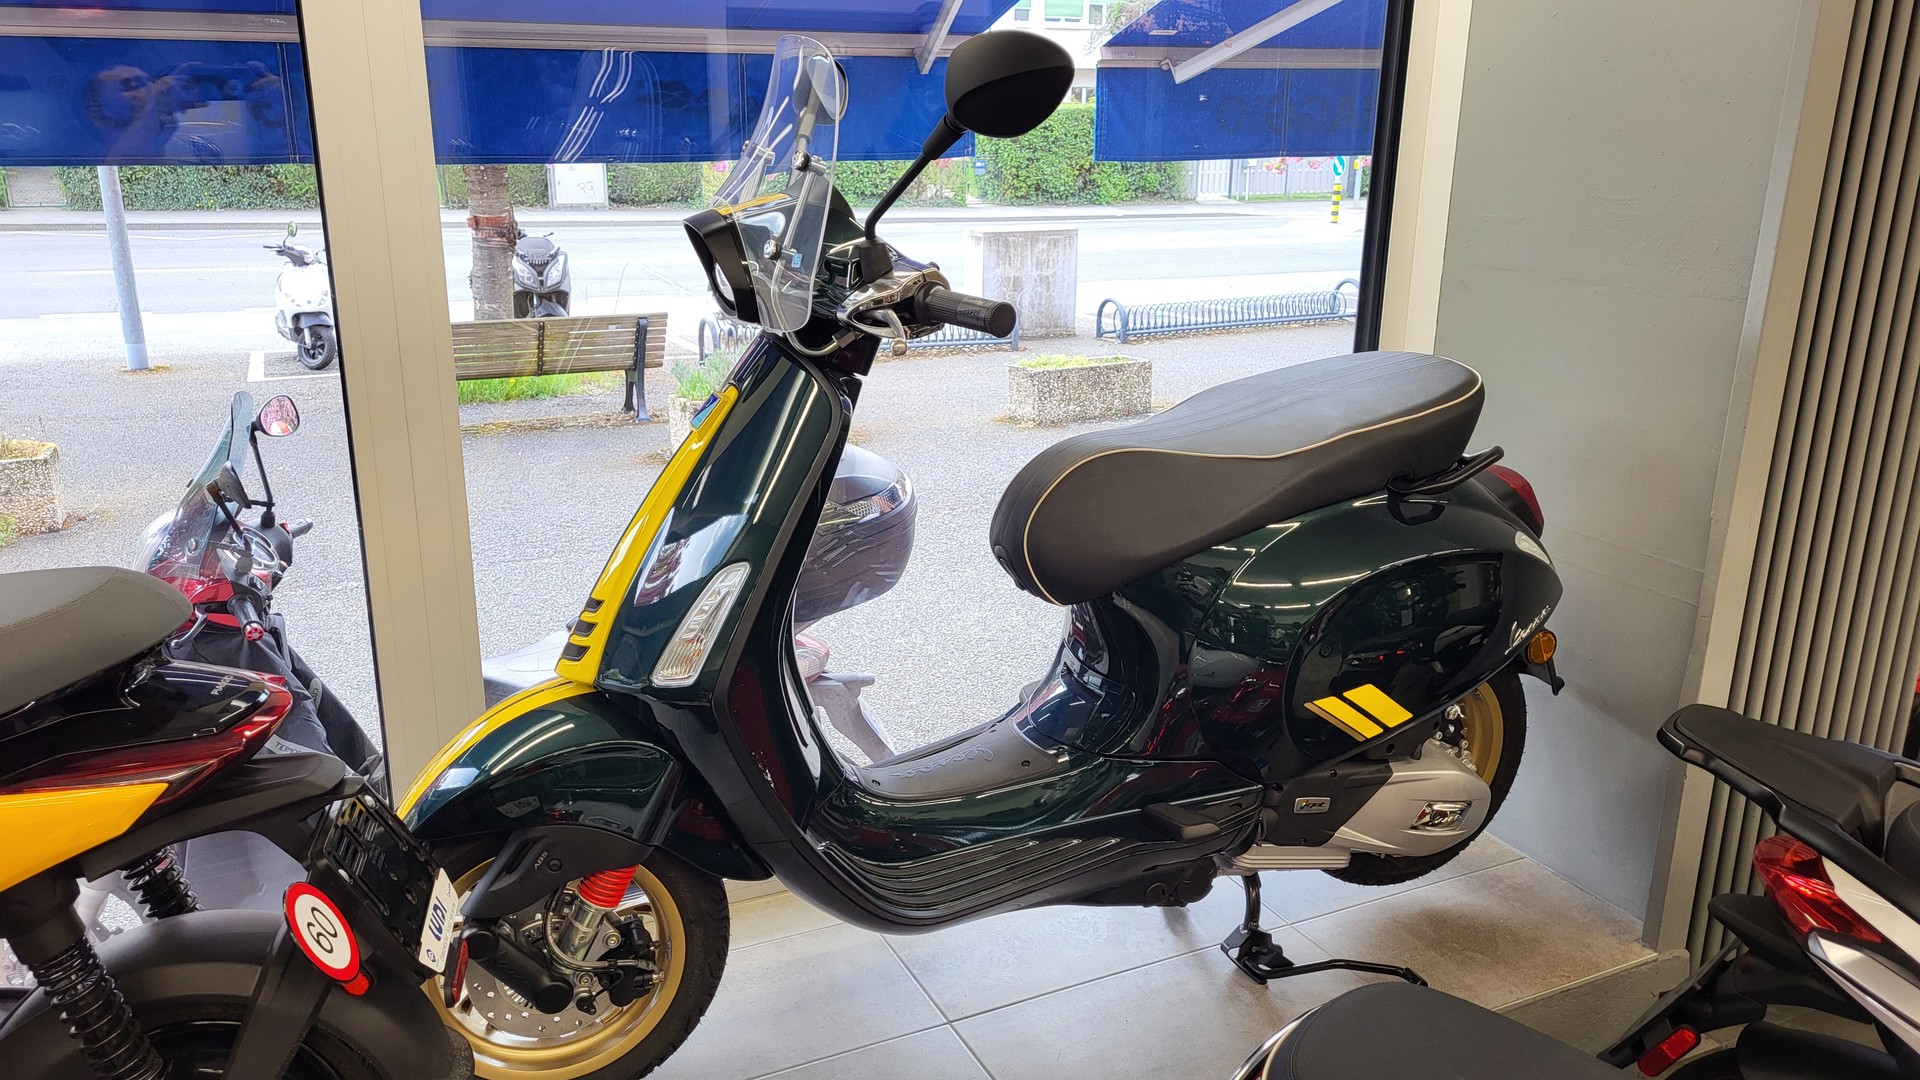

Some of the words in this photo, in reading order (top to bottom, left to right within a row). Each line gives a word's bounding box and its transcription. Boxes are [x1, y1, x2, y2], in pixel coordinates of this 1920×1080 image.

[534, 850, 548, 871] ABS
[307, 906, 338, 955] 60
[428, 895, 448, 942] LUDI
